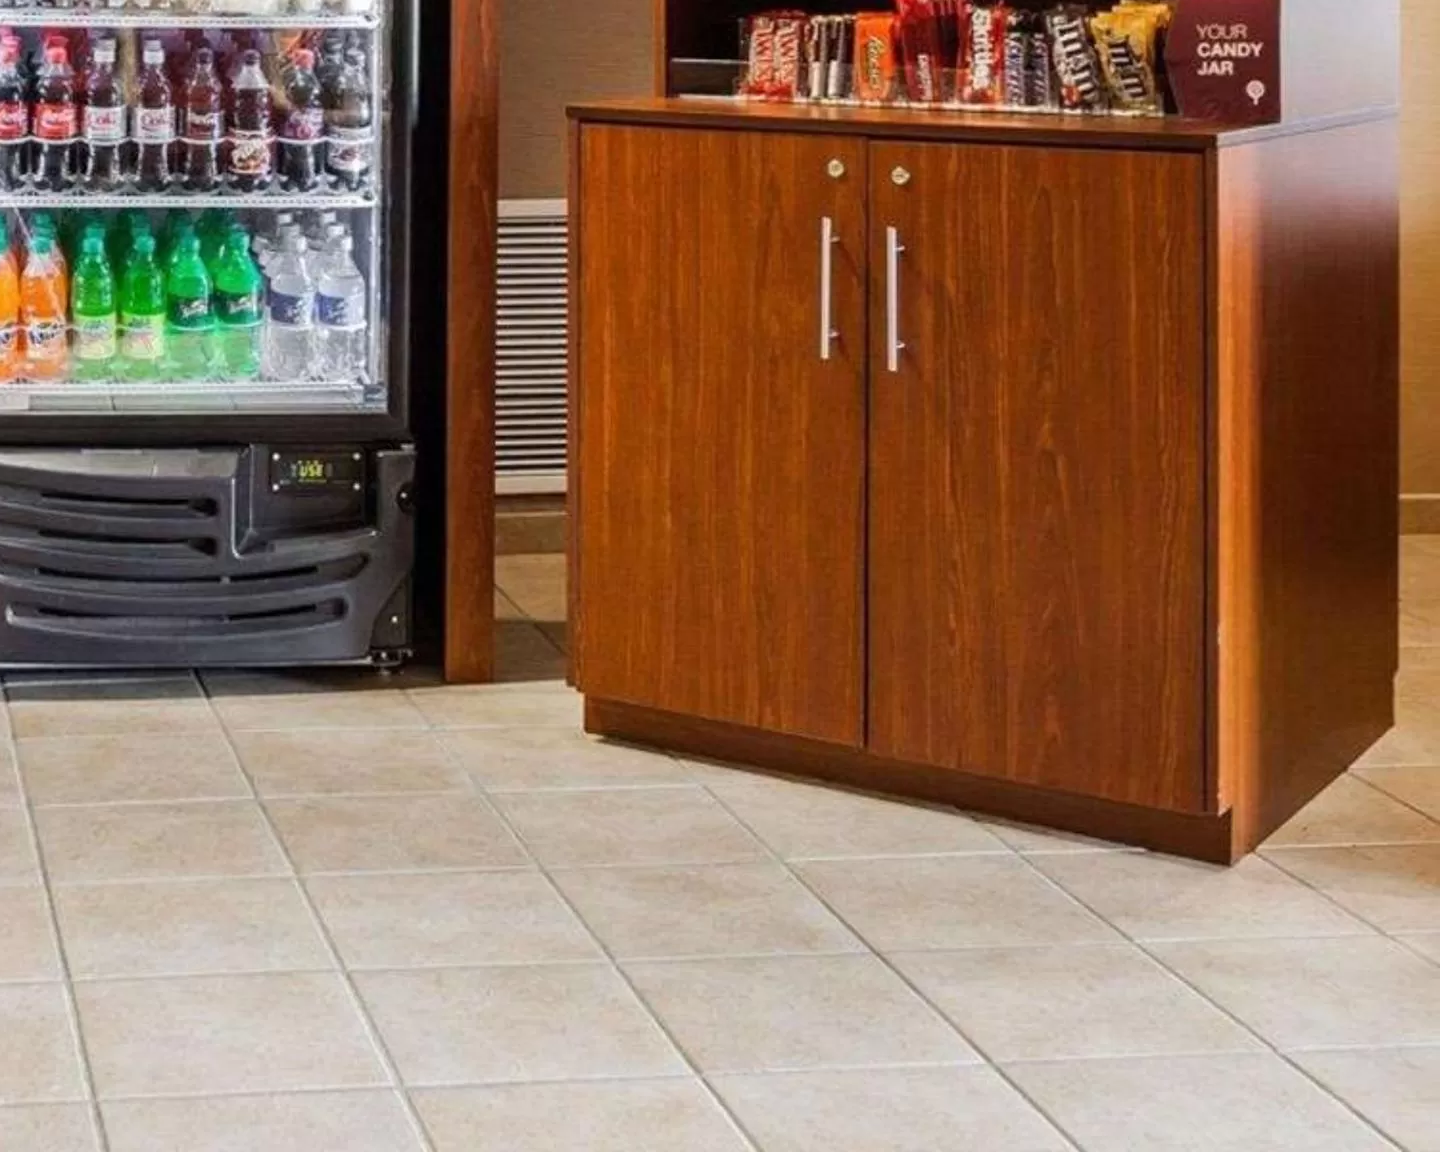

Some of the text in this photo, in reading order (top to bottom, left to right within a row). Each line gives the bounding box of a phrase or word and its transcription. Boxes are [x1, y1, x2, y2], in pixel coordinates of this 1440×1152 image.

[1195, 23, 1248, 40] YOUR
[1196, 41, 1265, 58] CANDY
[1196, 60, 1235, 76] JAR
